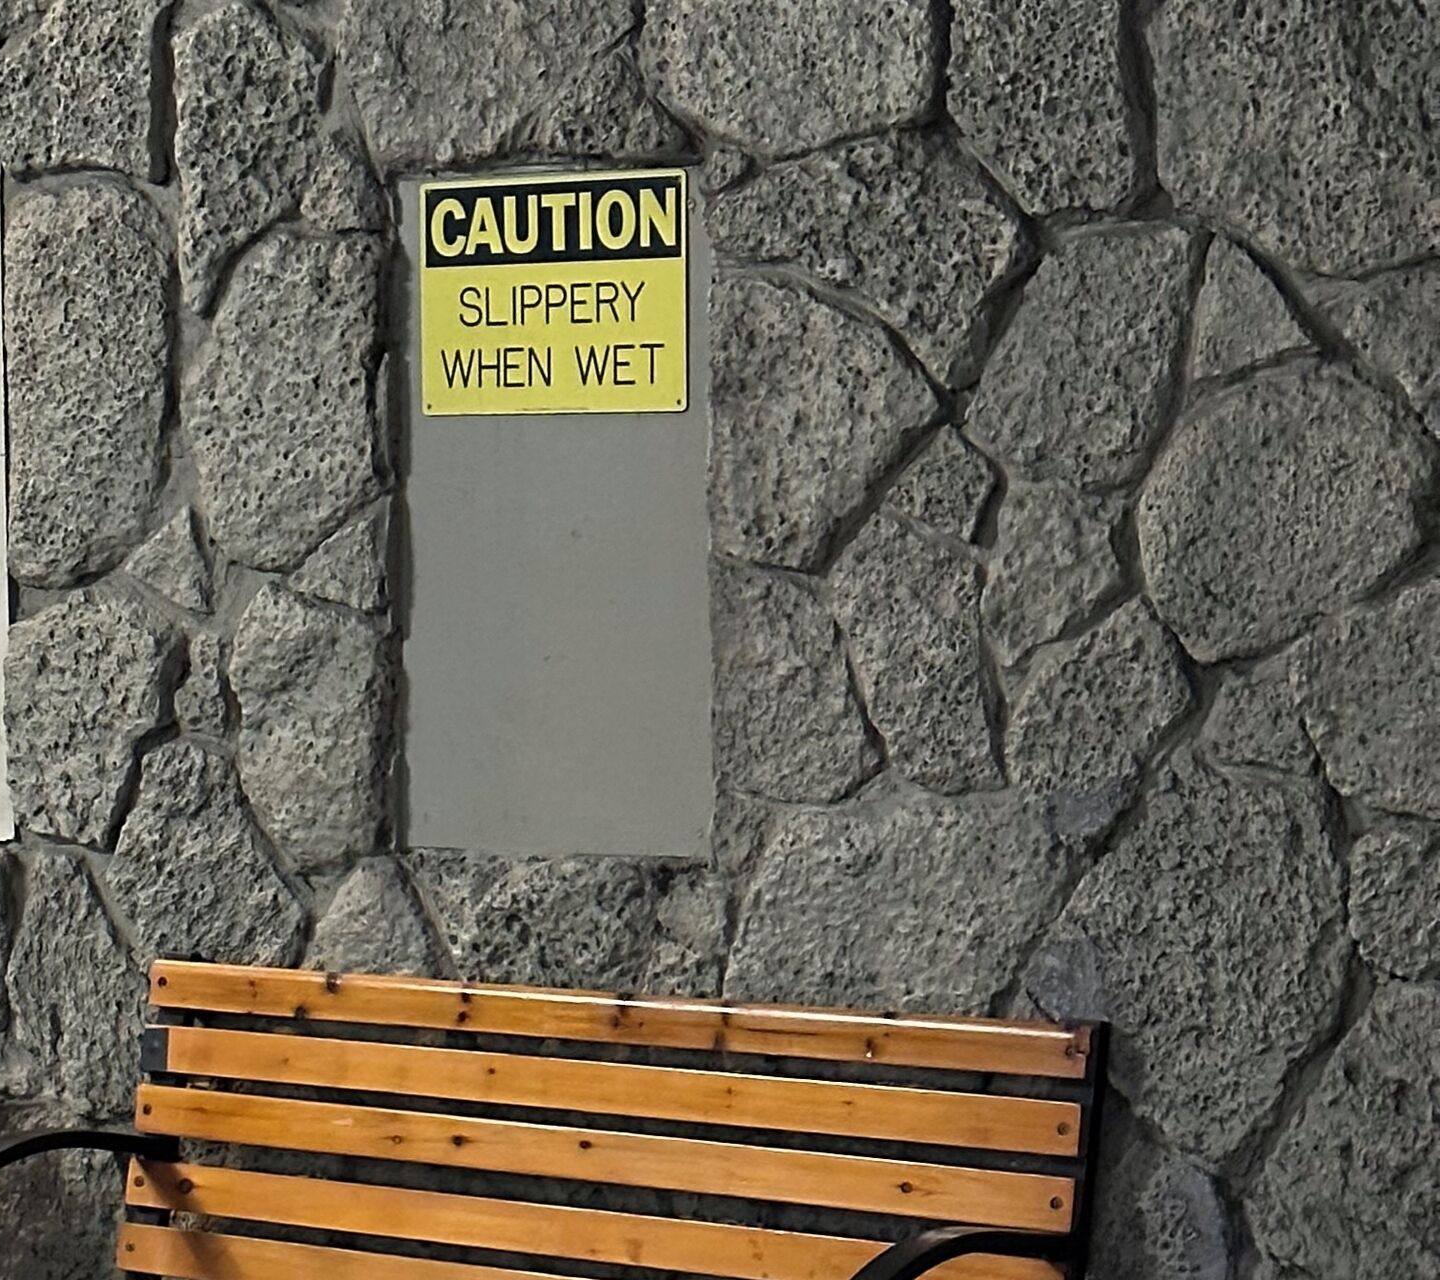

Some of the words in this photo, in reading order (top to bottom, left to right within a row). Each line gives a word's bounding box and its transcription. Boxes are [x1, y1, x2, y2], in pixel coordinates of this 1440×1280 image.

[430, 187, 677, 257] CAUTION
[459, 280, 646, 328] SLIPPERY
[441, 346, 552, 389] WHEN
[575, 343, 665, 386] WET
